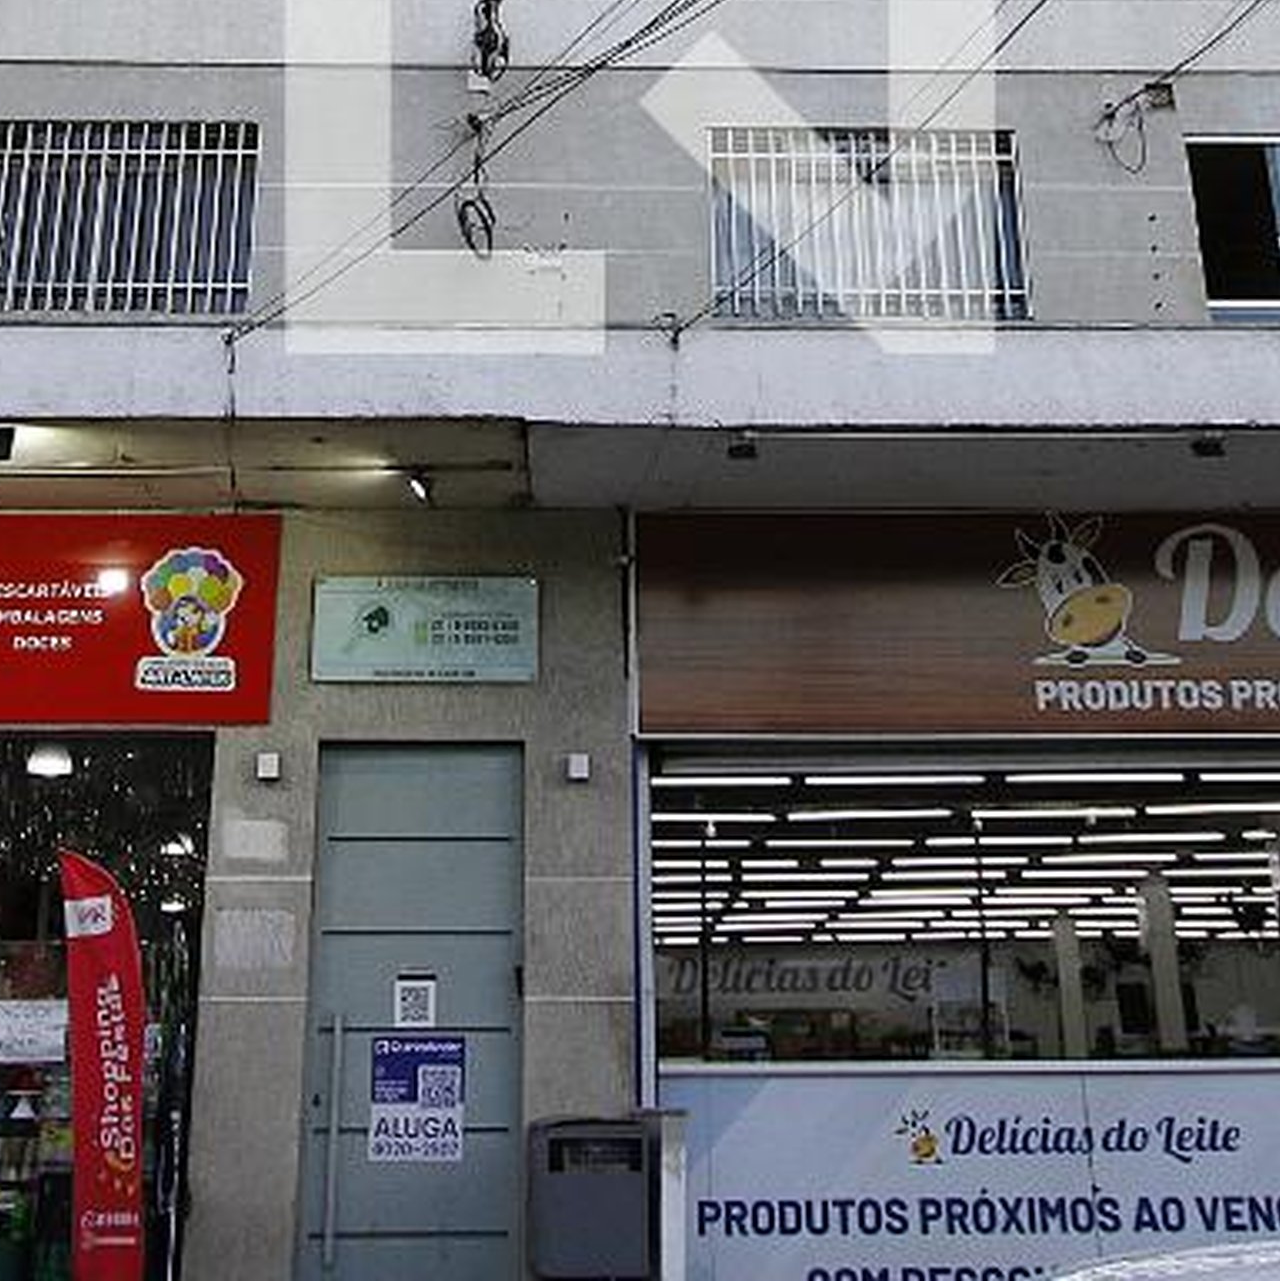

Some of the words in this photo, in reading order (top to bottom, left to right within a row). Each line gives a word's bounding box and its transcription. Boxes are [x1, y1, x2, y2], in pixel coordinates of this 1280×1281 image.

[1035, 678, 1222, 711] PRODUTOS
[374, 1117, 458, 1139] ALUGA
[1102, 1118, 1149, 1153] do
[1155, 1116, 1242, 1163] Leite
[697, 1198, 910, 1236] PRODUTOS
[920, 1187, 1121, 1235] PRÓXIMOS
[1133, 1195, 1187, 1233] AO
